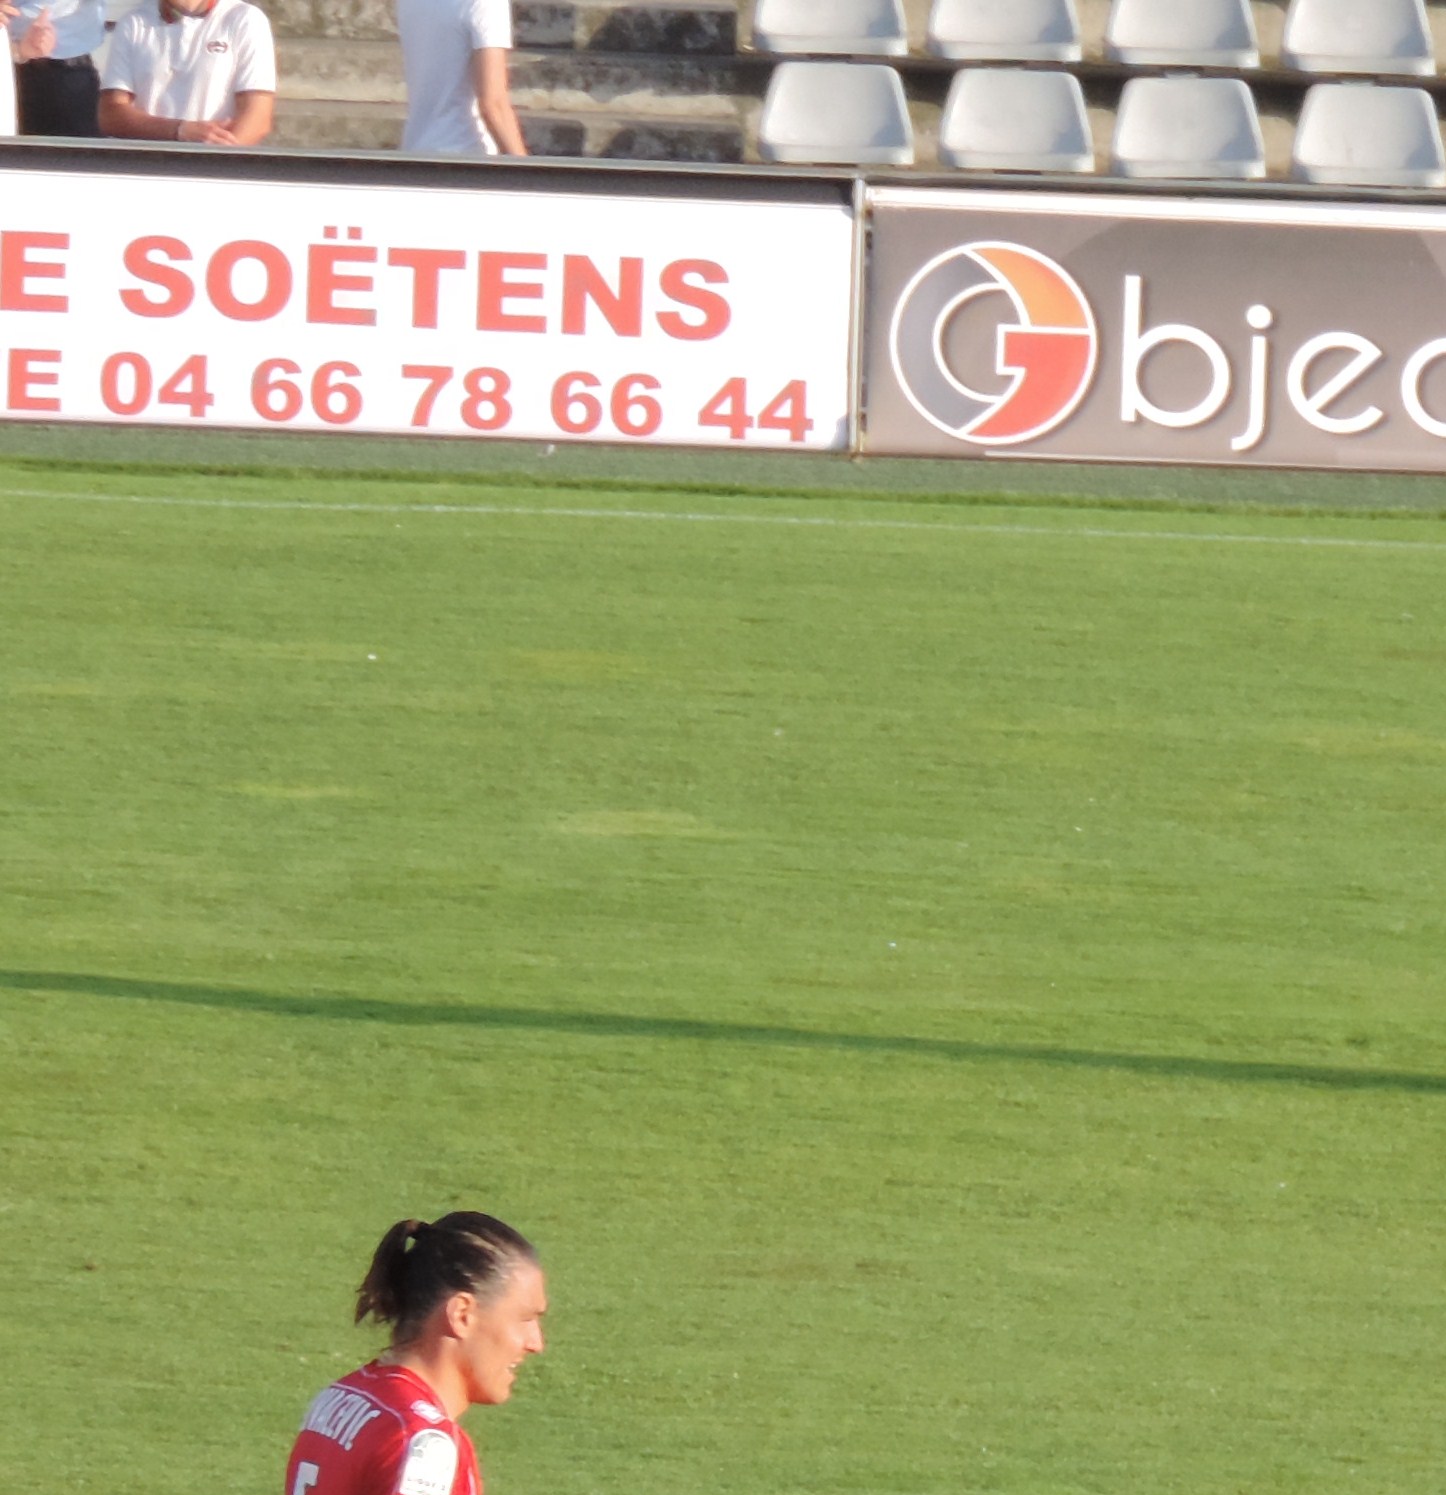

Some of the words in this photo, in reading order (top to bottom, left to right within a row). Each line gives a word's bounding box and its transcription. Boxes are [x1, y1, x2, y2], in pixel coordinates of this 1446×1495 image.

[119, 226, 732, 341] SOËTENS
[8, 349, 62, 412] E
[101, 351, 214, 418] 04
[251, 357, 363, 426] 66
[402, 364, 513, 432] 78
[551, 371, 663, 438] 66
[698, 377, 814, 443] 44
